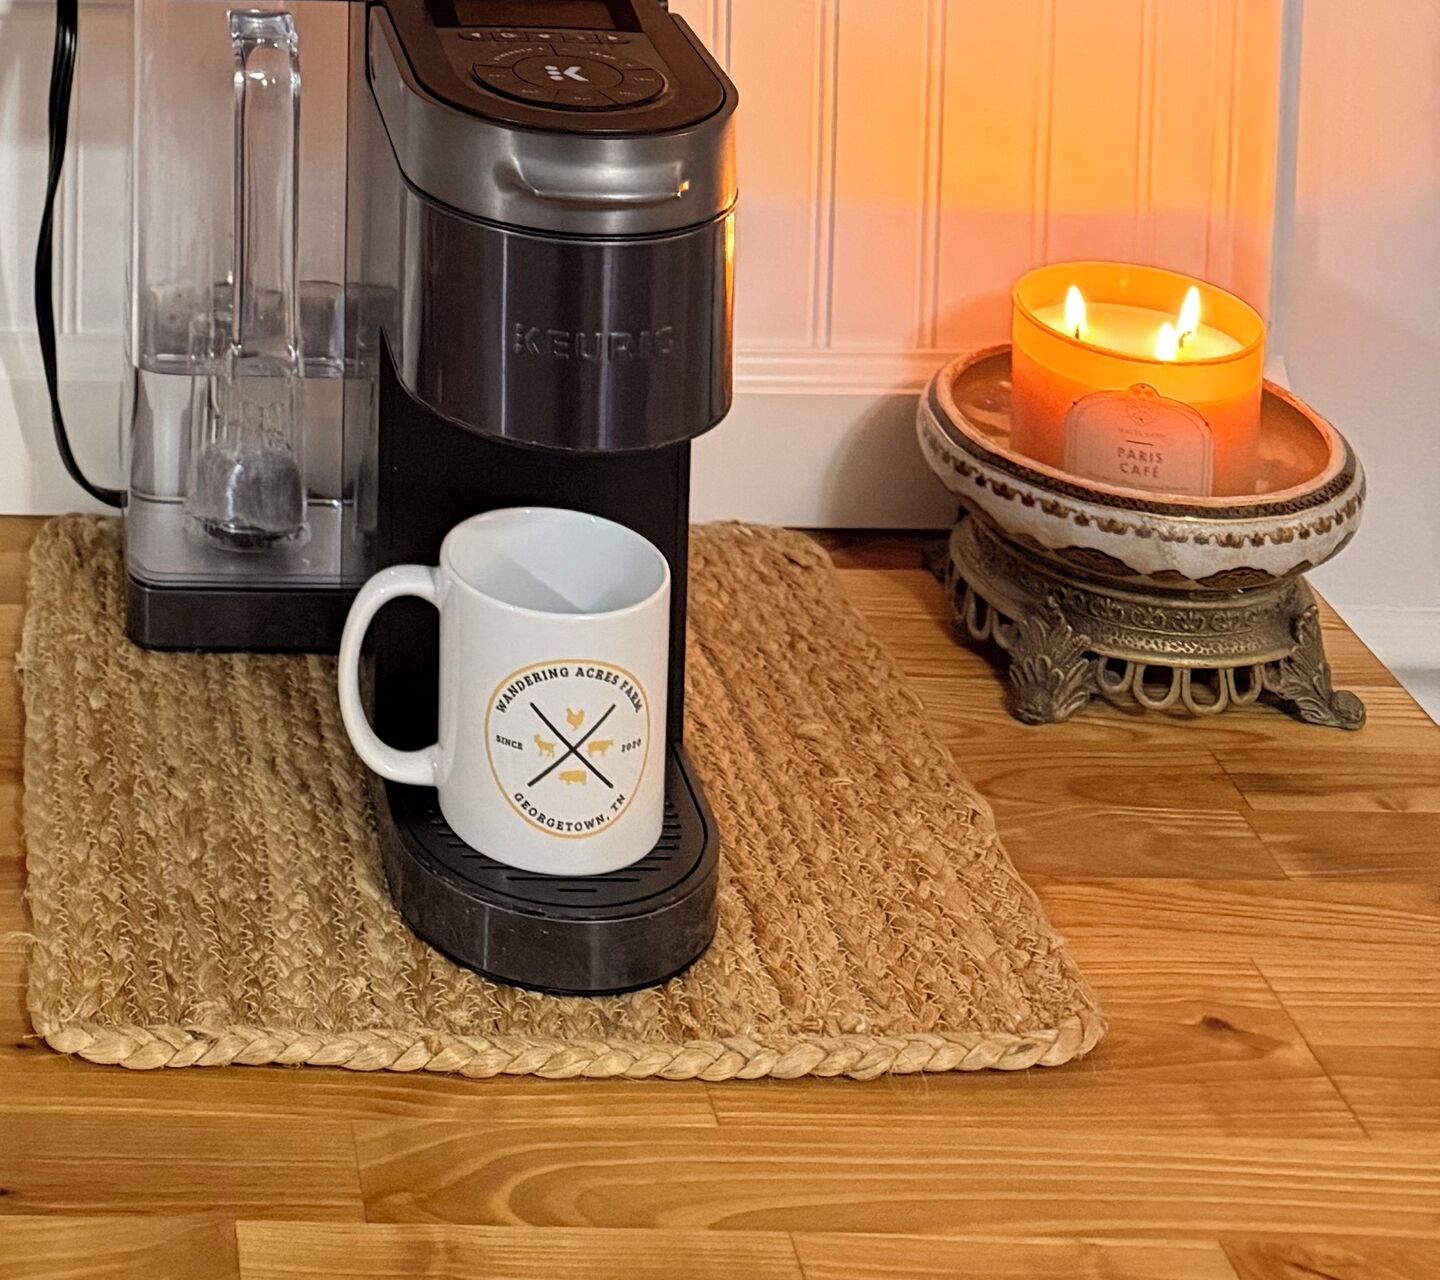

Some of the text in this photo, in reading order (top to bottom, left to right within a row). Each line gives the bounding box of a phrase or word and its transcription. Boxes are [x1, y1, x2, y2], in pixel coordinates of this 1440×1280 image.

[513, 322, 677, 362] KEURIG
[1118, 447, 1163, 464] PARIS
[496, 667, 643, 713] WANDERING ACRES FARM
[496, 734, 524, 750] SINCE
[514, 792, 626, 832] GEORGETOWN, TN
